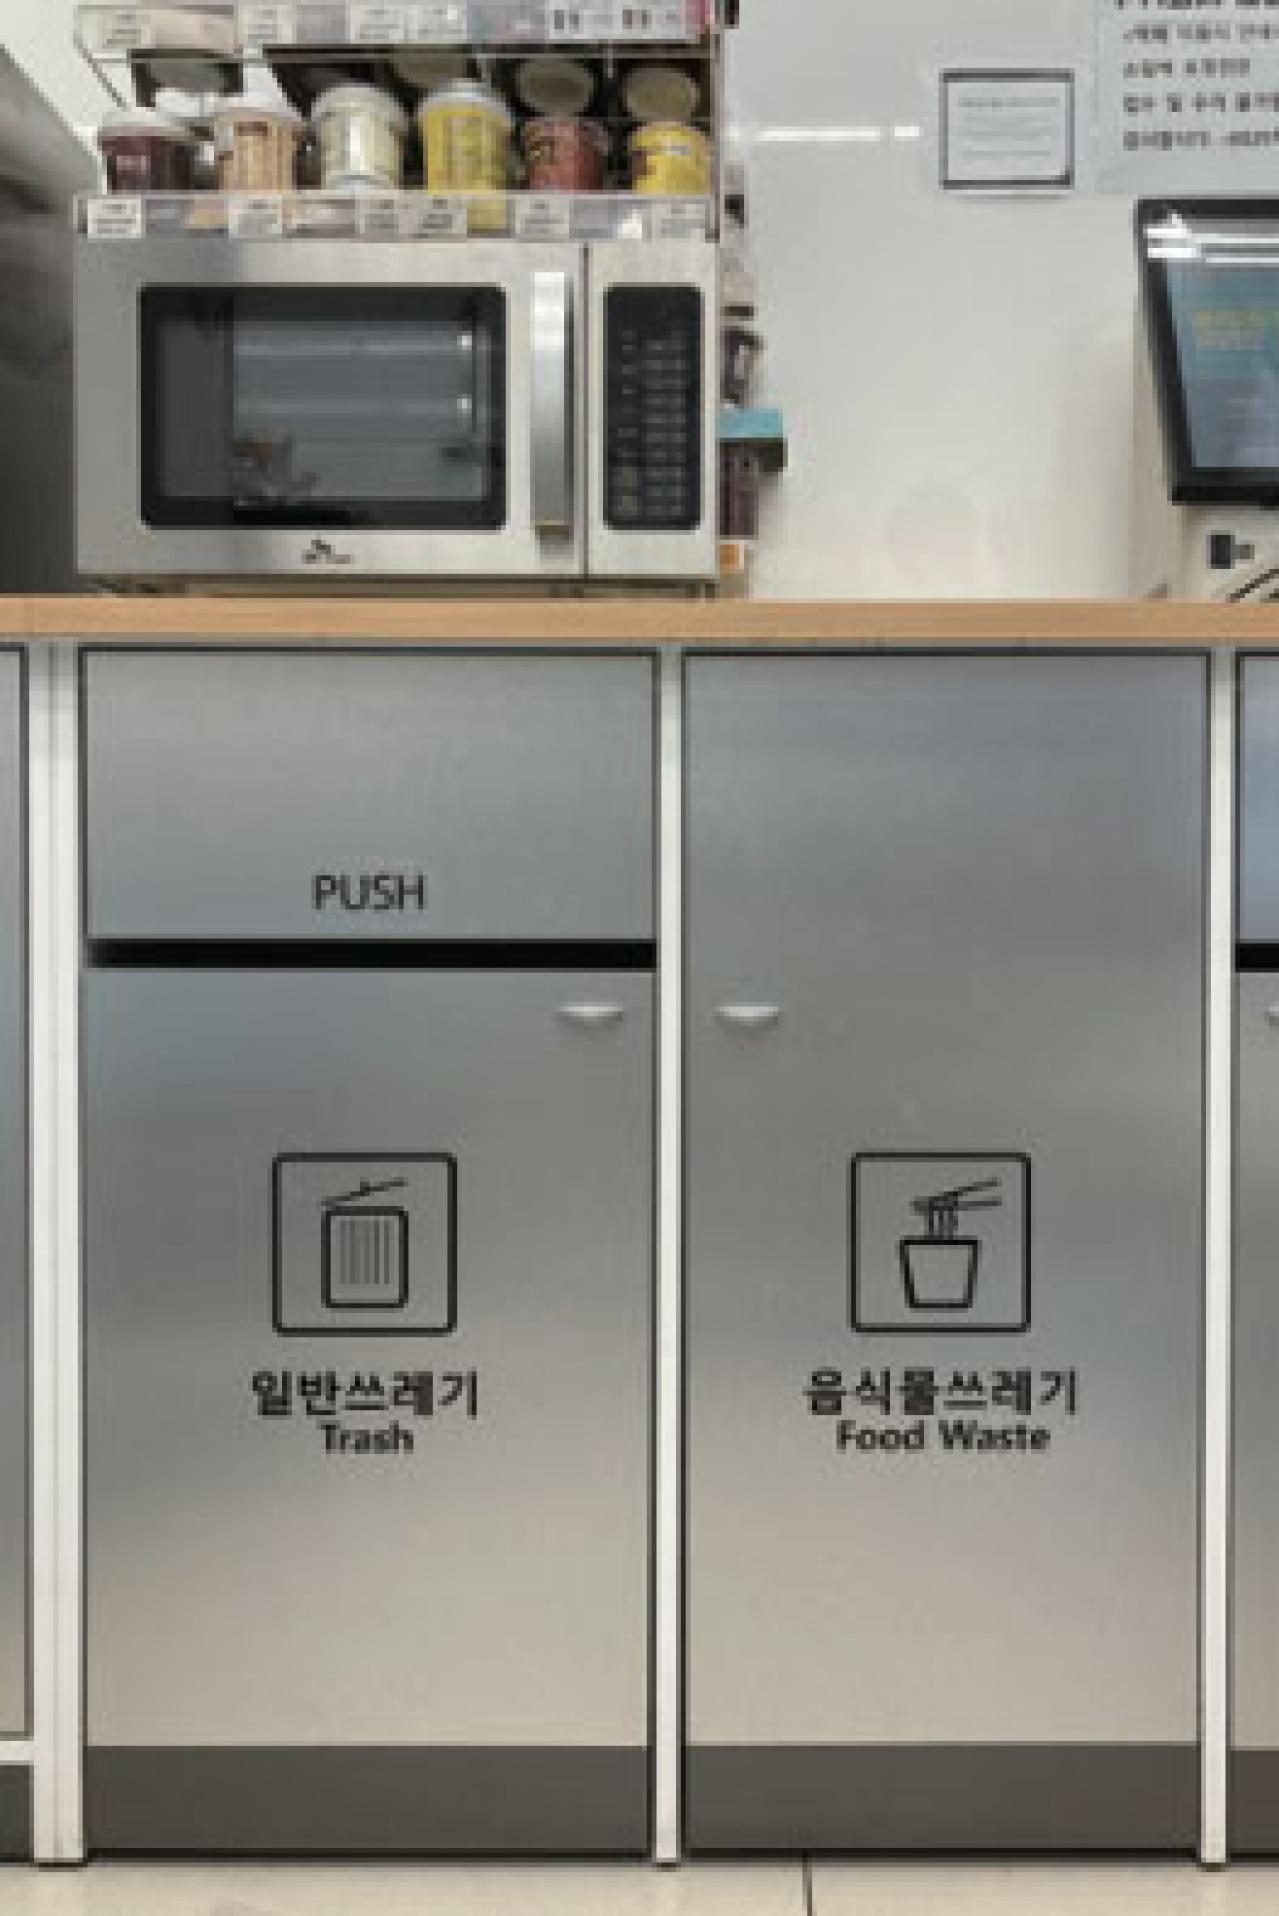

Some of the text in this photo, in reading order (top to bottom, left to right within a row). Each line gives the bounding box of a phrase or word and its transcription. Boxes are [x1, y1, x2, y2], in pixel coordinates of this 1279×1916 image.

[313, 873, 427, 911] PUSH
[252, 1370, 477, 1419] 일반쓰레기
[803, 1367, 1079, 1416] 음식물쓰레기
[318, 1421, 414, 1454] Trash
[836, 1420, 1051, 1453] Food Waste
